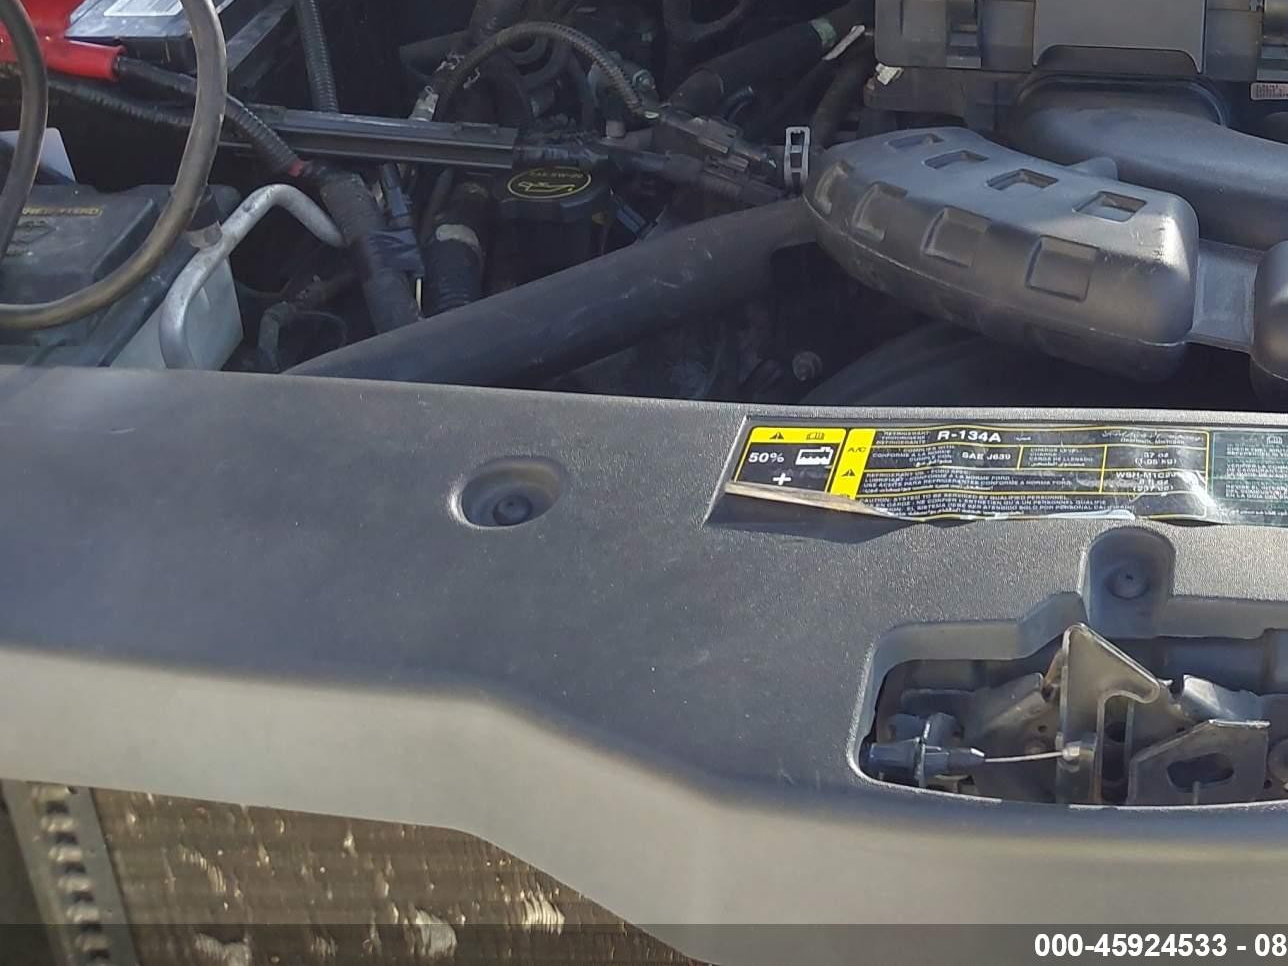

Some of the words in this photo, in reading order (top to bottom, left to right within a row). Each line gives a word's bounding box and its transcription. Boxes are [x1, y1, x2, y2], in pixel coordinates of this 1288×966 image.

[937, 430, 1002, 443] R-134A
[748, 452, 785, 463] 50%
[961, 451, 985, 460] SAE
